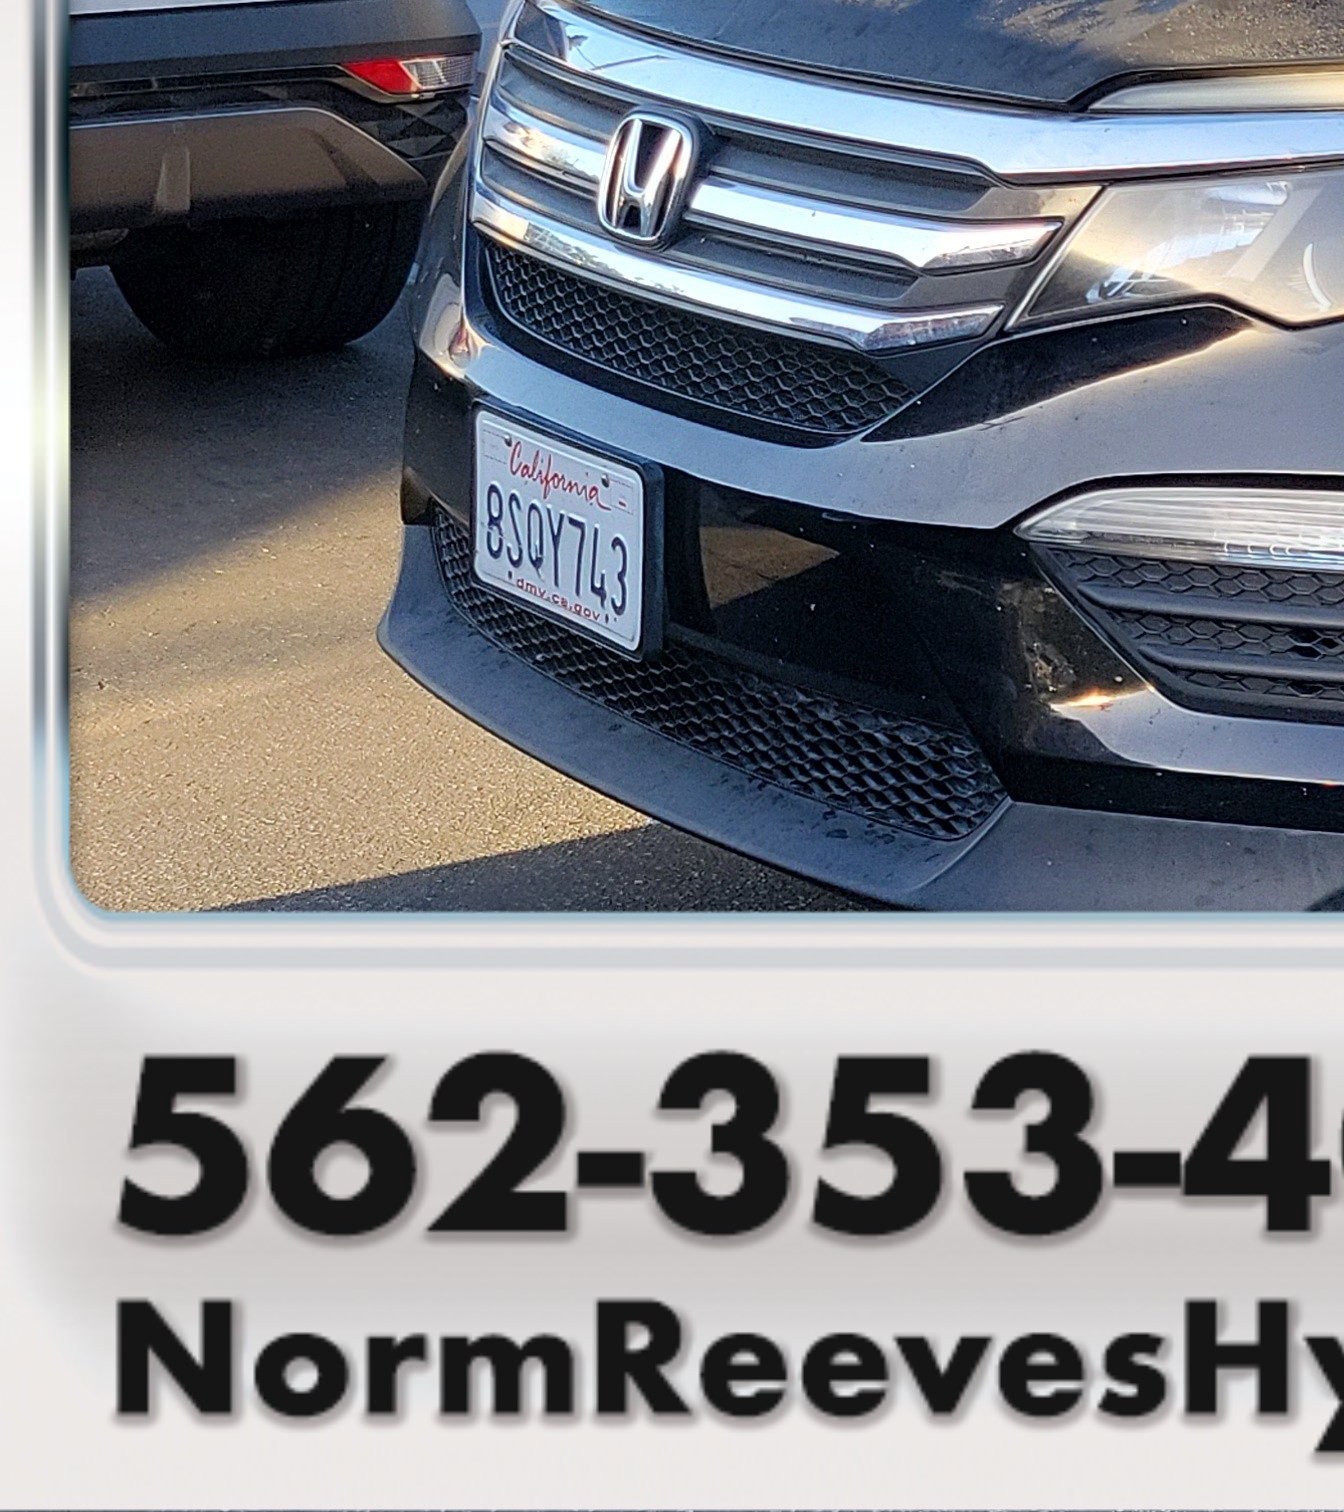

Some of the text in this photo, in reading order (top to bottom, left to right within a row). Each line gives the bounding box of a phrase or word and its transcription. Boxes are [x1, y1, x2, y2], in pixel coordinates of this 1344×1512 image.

[509, 440, 612, 512] California
[486, 482, 629, 617] 8SQY743
[515, 577, 601, 623] dmv.ca.gov
